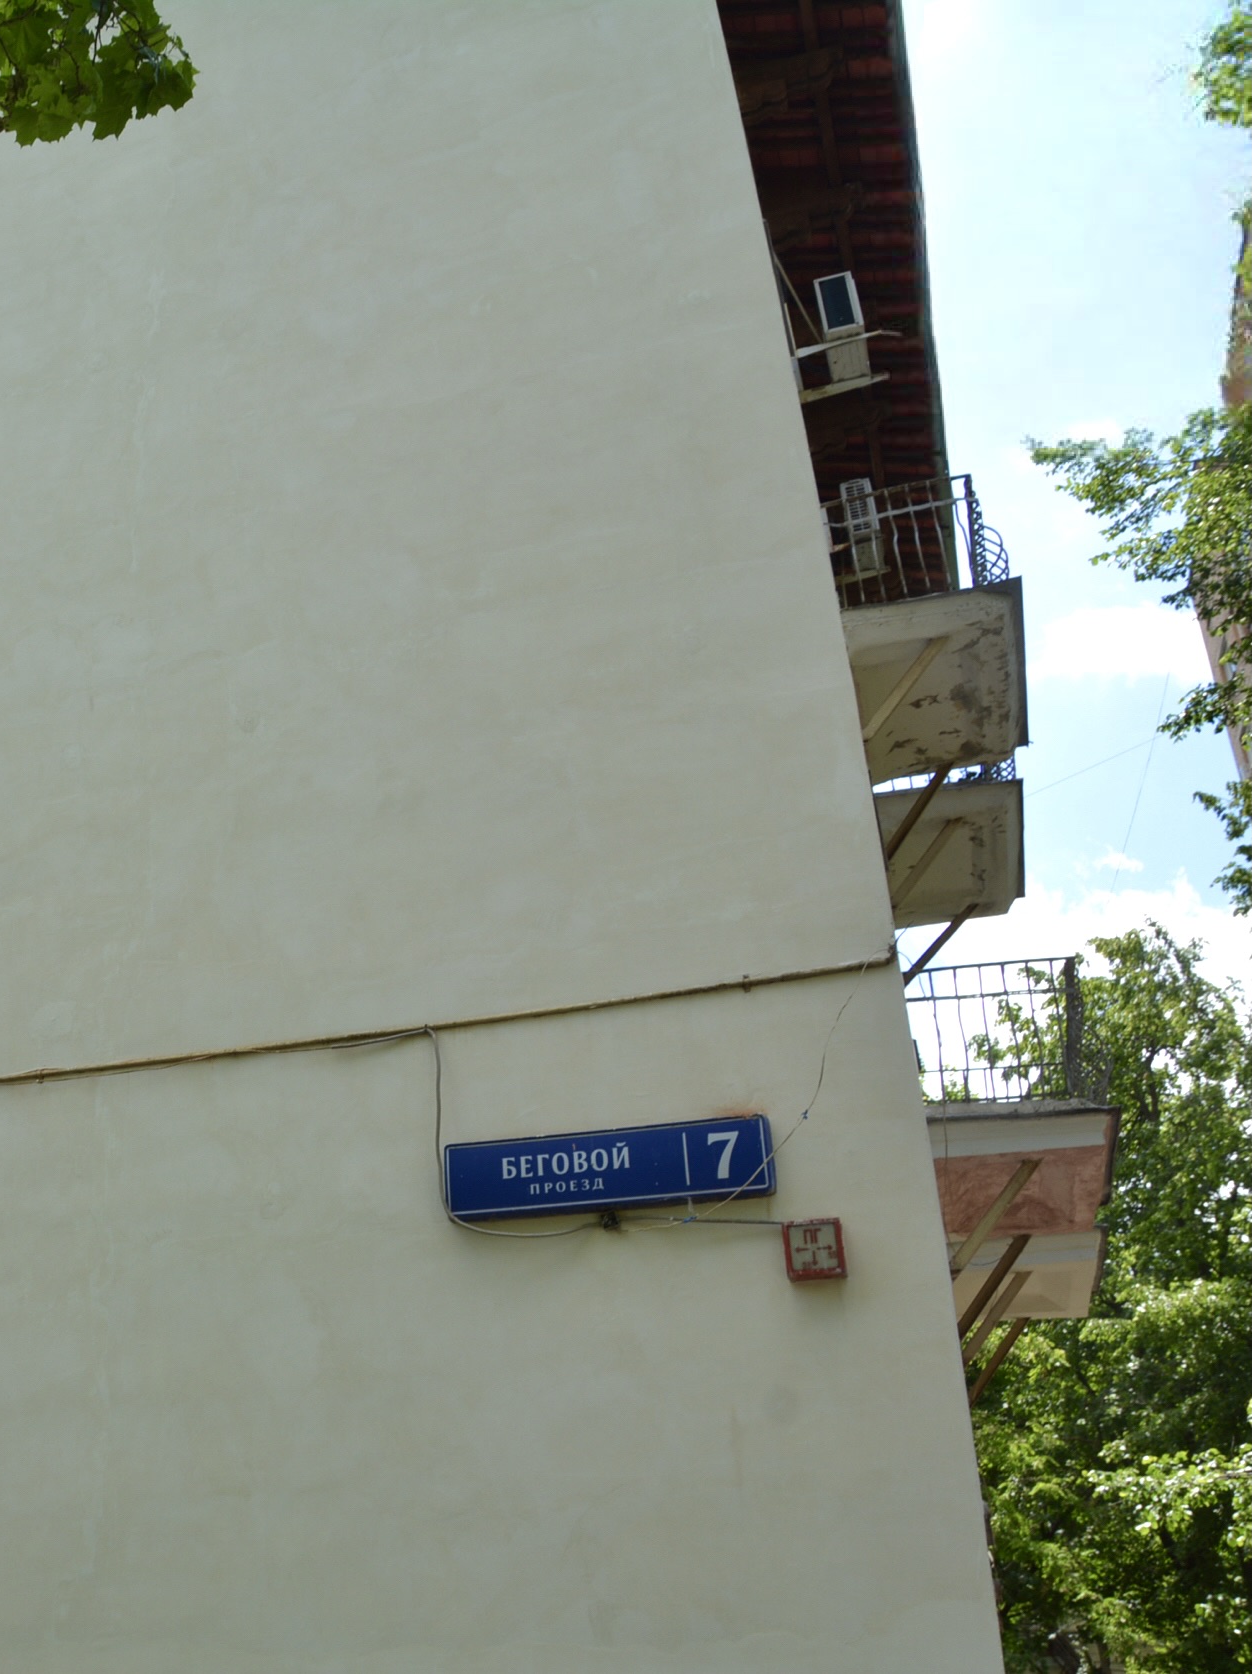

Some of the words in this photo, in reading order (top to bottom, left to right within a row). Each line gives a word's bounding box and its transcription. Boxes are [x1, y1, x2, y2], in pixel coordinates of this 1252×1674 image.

[501, 1143, 631, 1180] БЕГОВОЙ
[707, 1131, 740, 1180] 7
[529, 1178, 605, 1196] ПРОЕЗД
[803, 1228, 822, 1245] ПГ
